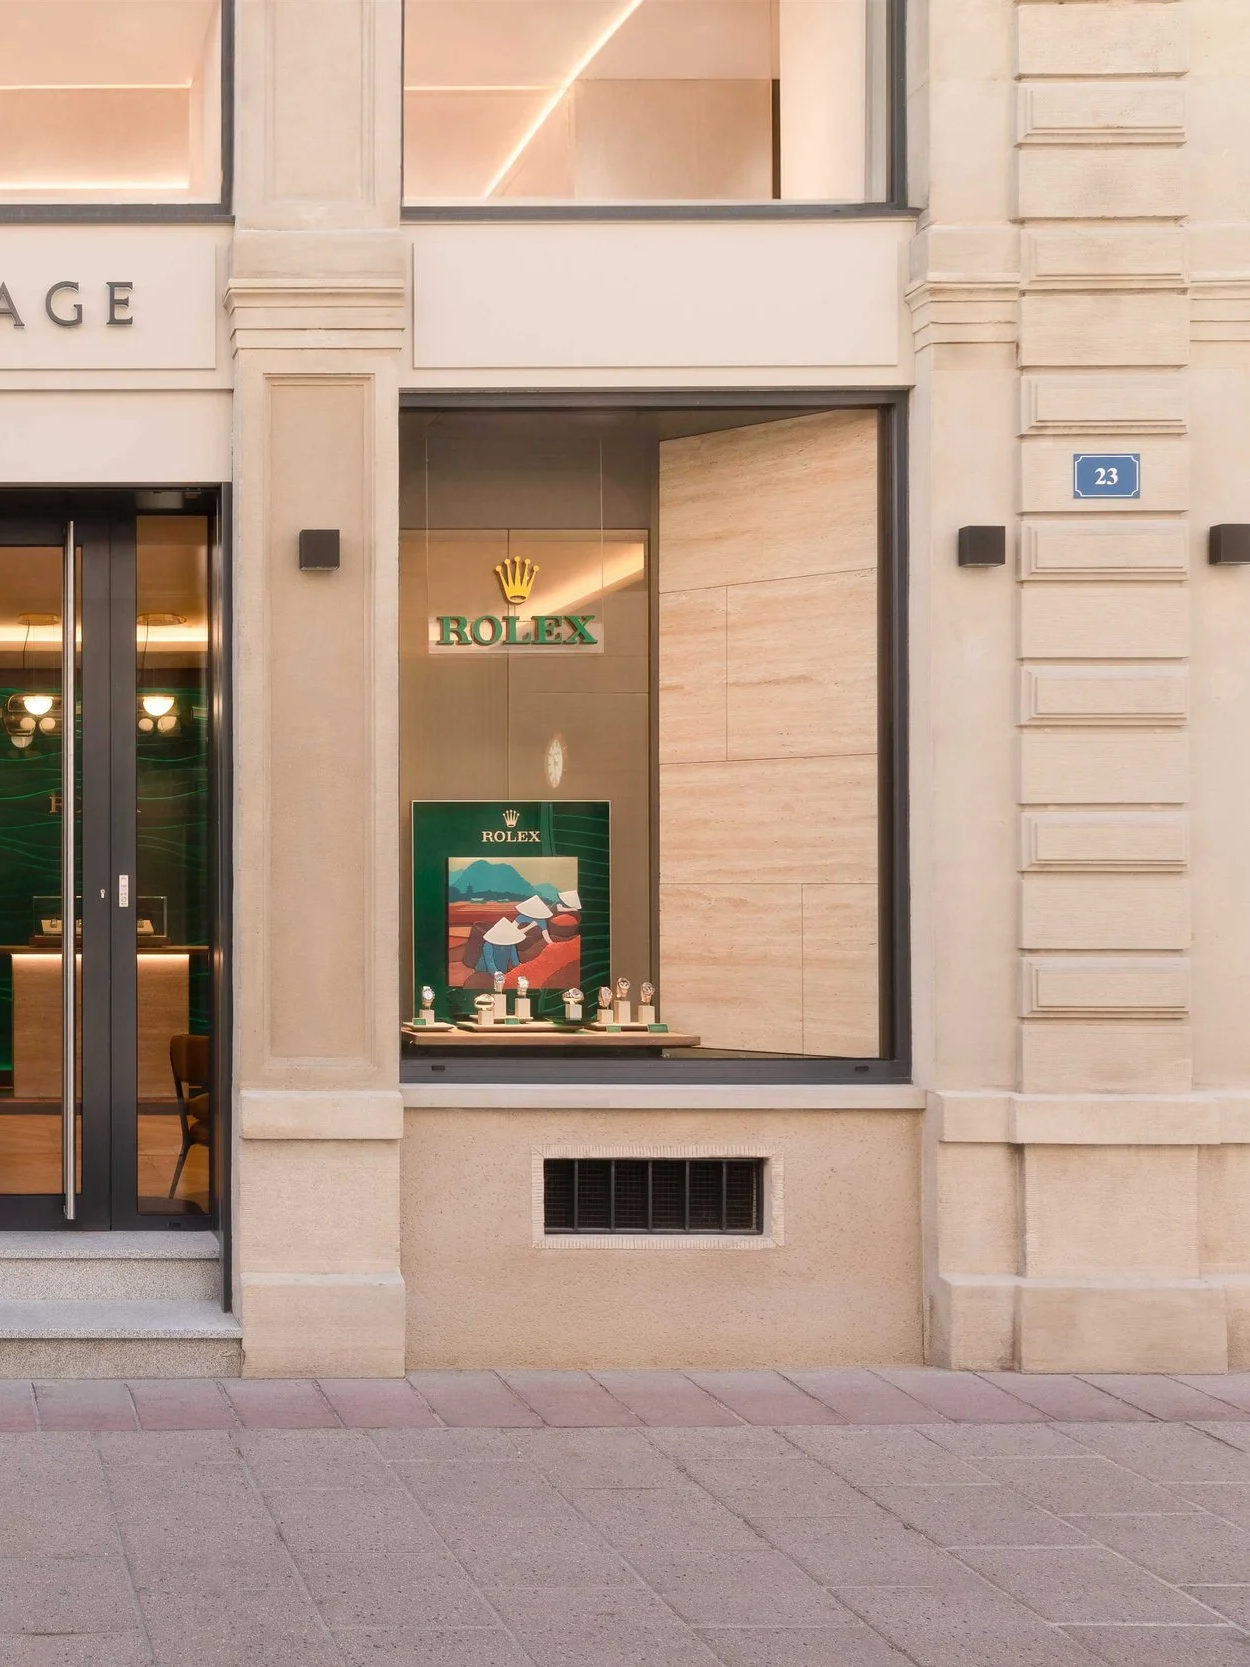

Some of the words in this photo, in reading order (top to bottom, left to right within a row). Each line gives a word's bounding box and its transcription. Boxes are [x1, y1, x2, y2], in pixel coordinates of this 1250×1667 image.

[1094, 467, 1119, 485] 23
[437, 615, 598, 645] ROLEX
[481, 830, 541, 843] ROLEX
